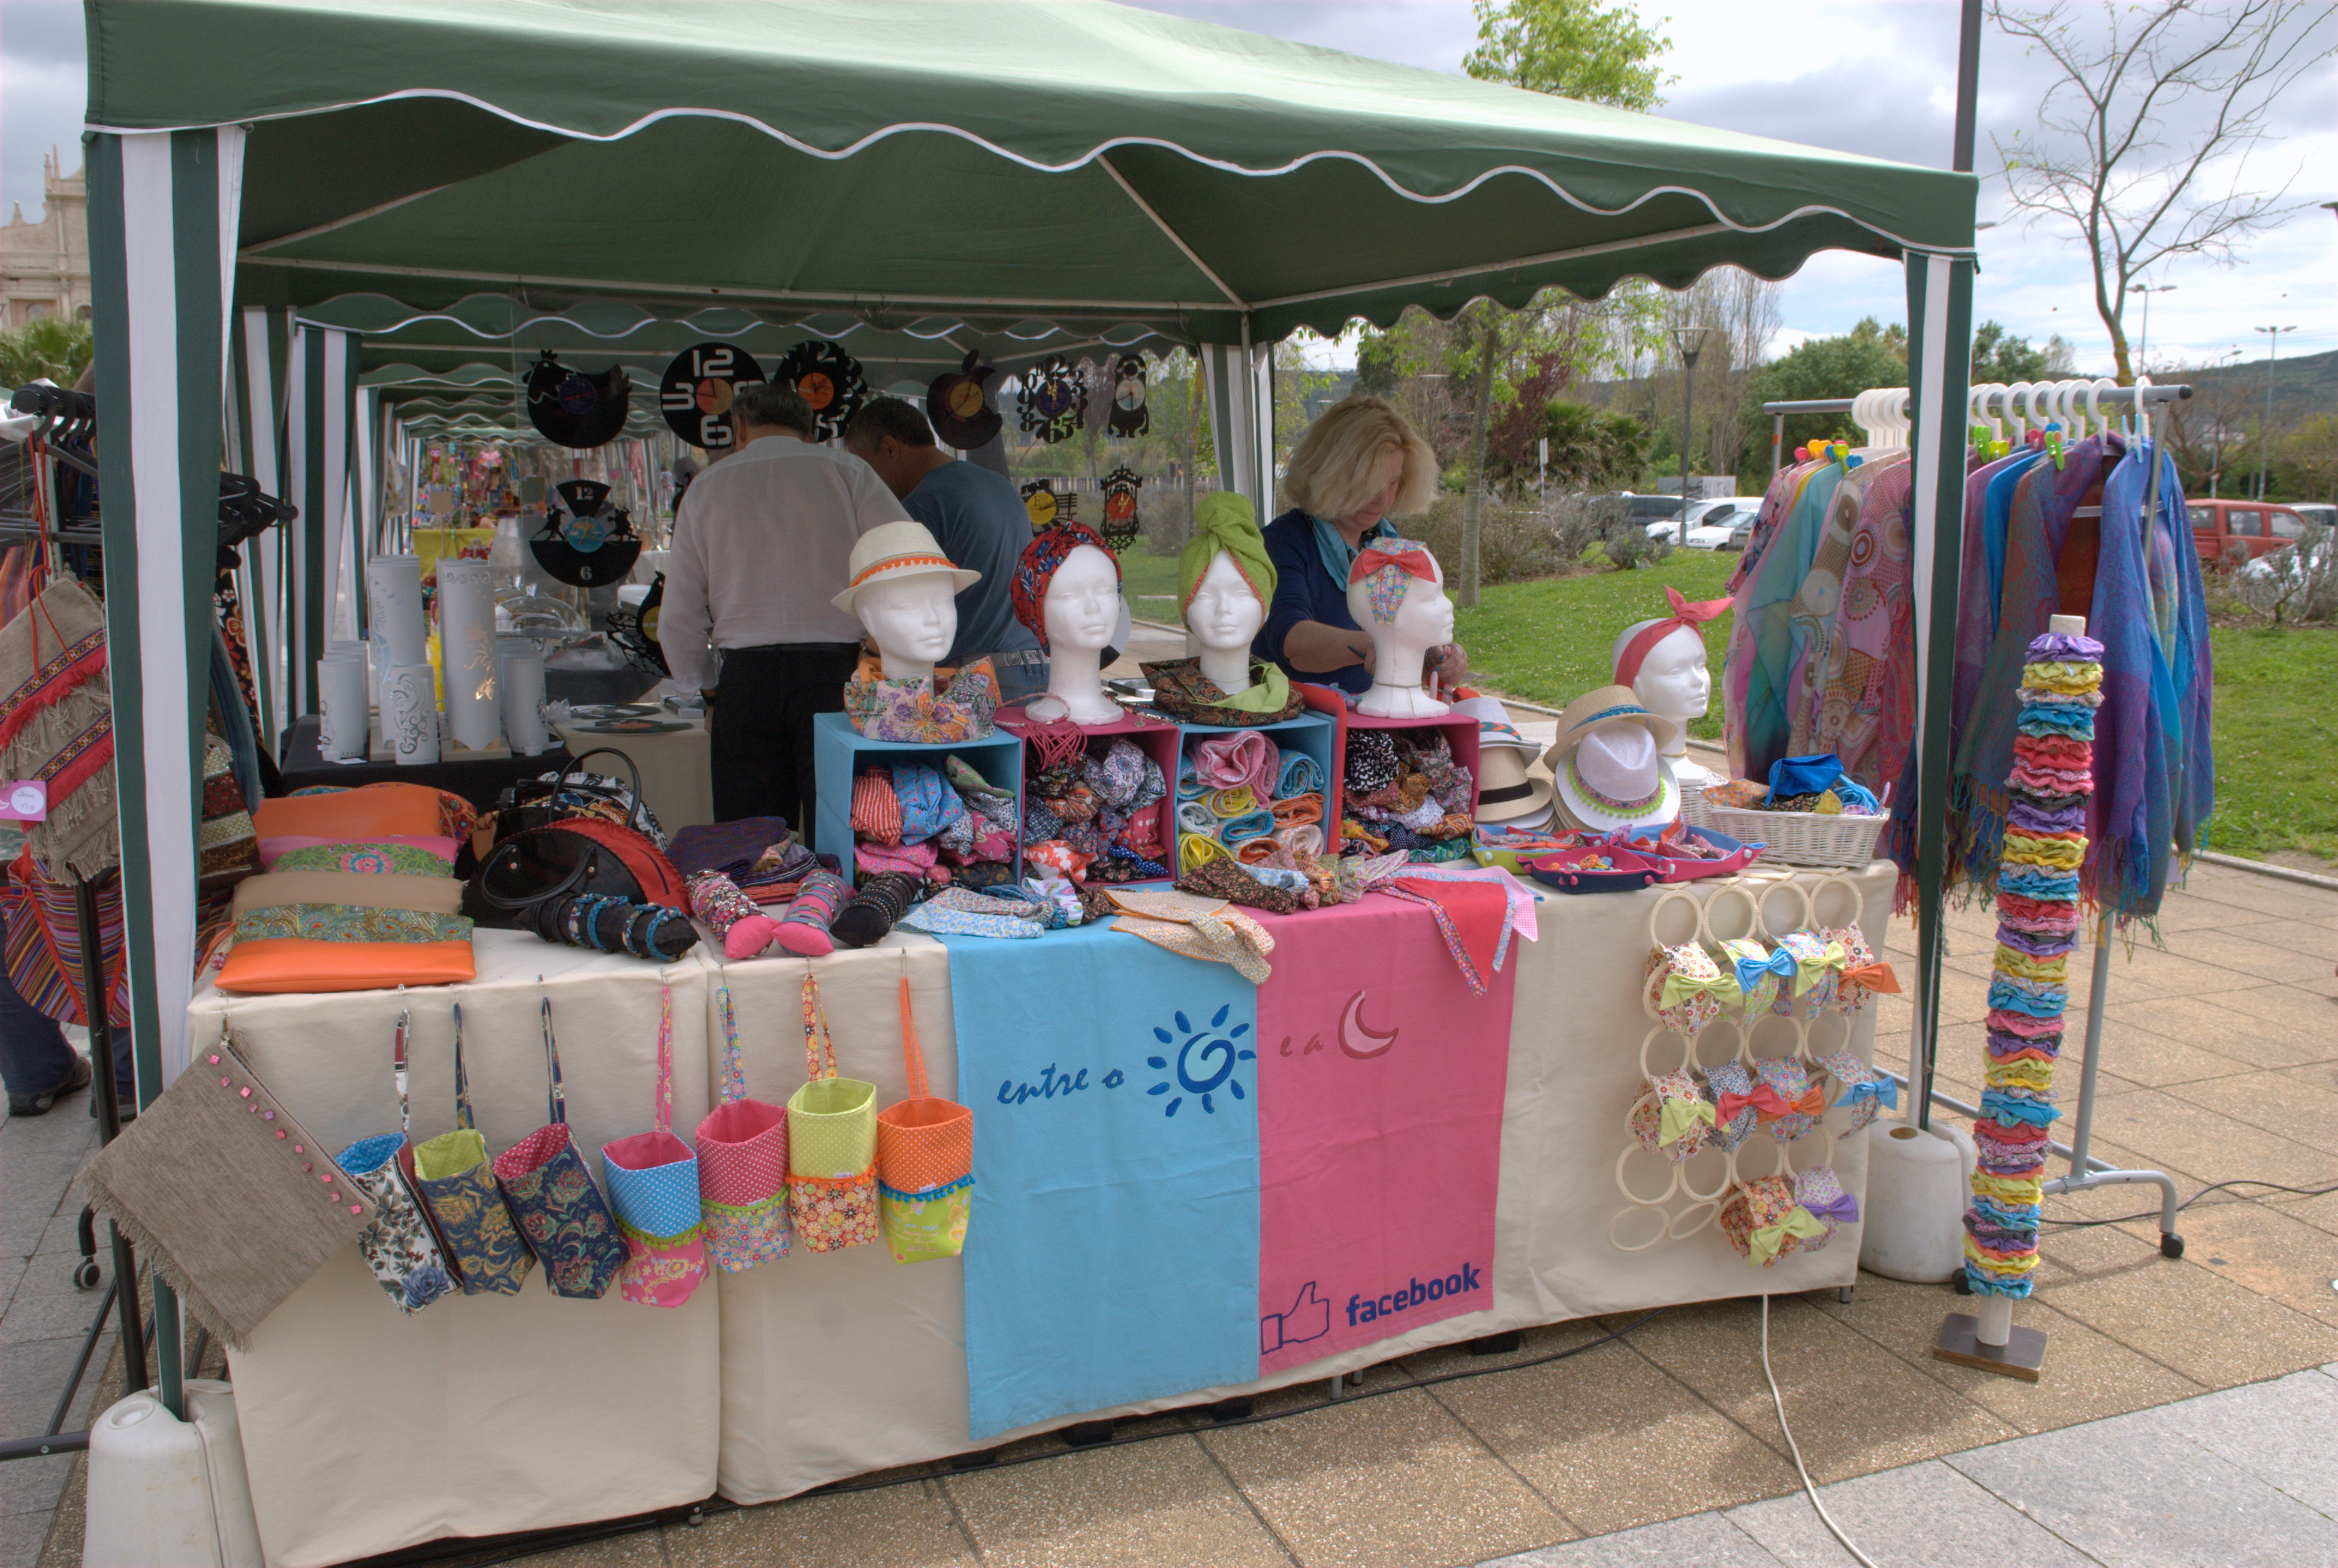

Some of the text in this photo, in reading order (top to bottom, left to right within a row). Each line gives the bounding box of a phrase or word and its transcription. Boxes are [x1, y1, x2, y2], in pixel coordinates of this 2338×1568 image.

[692, 348, 734, 377] 12
[700, 415, 733, 446] 6
[576, 486, 594, 500] 12
[580, 565, 593, 581] 6
[997, 1032, 1324, 1105] entre o e a
[1346, 1262, 1481, 1327] facebook
